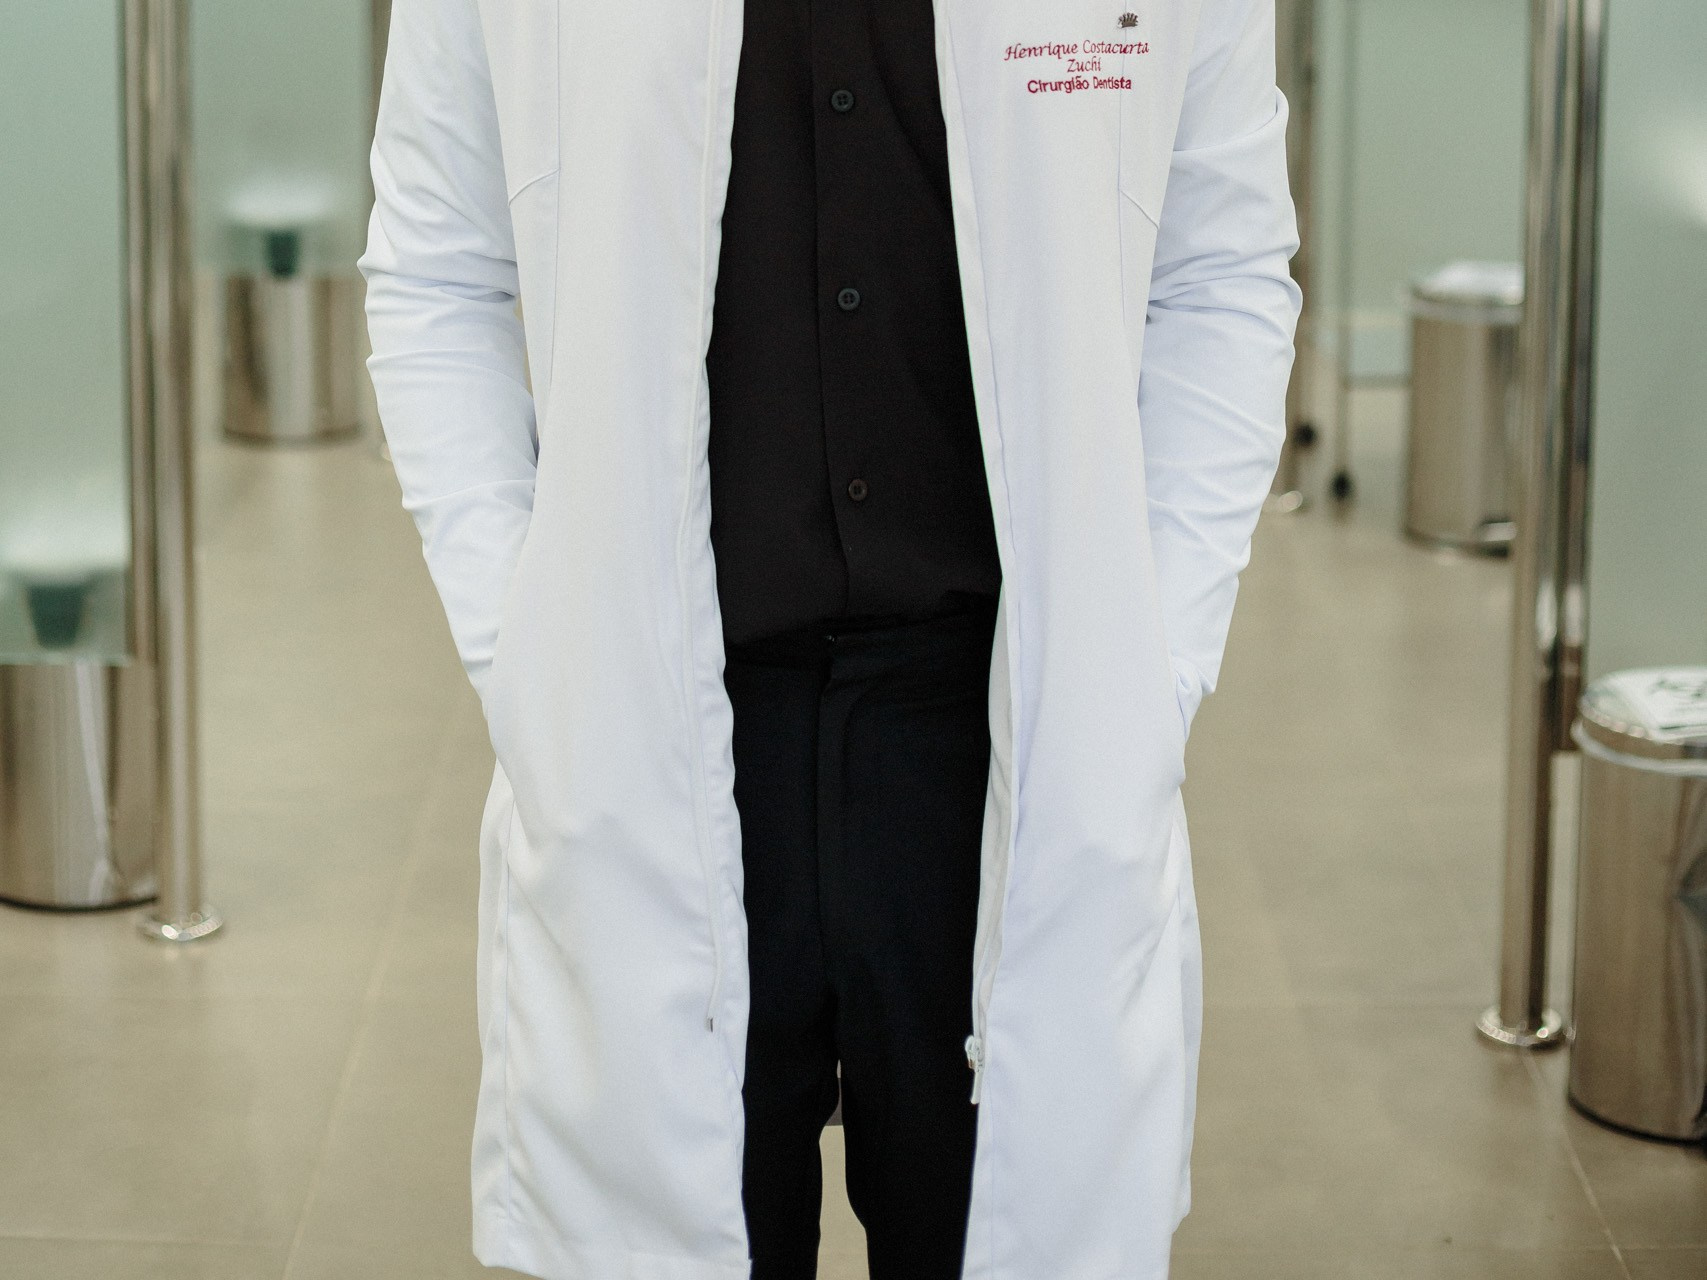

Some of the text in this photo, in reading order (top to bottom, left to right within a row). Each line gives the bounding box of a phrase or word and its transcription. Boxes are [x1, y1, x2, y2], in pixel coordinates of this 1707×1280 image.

[1003, 39, 1150, 61] Henrique Costacurta
[1066, 56, 1102, 73] Zuchi
[1027, 75, 1132, 94] Cirurgião Dentista
